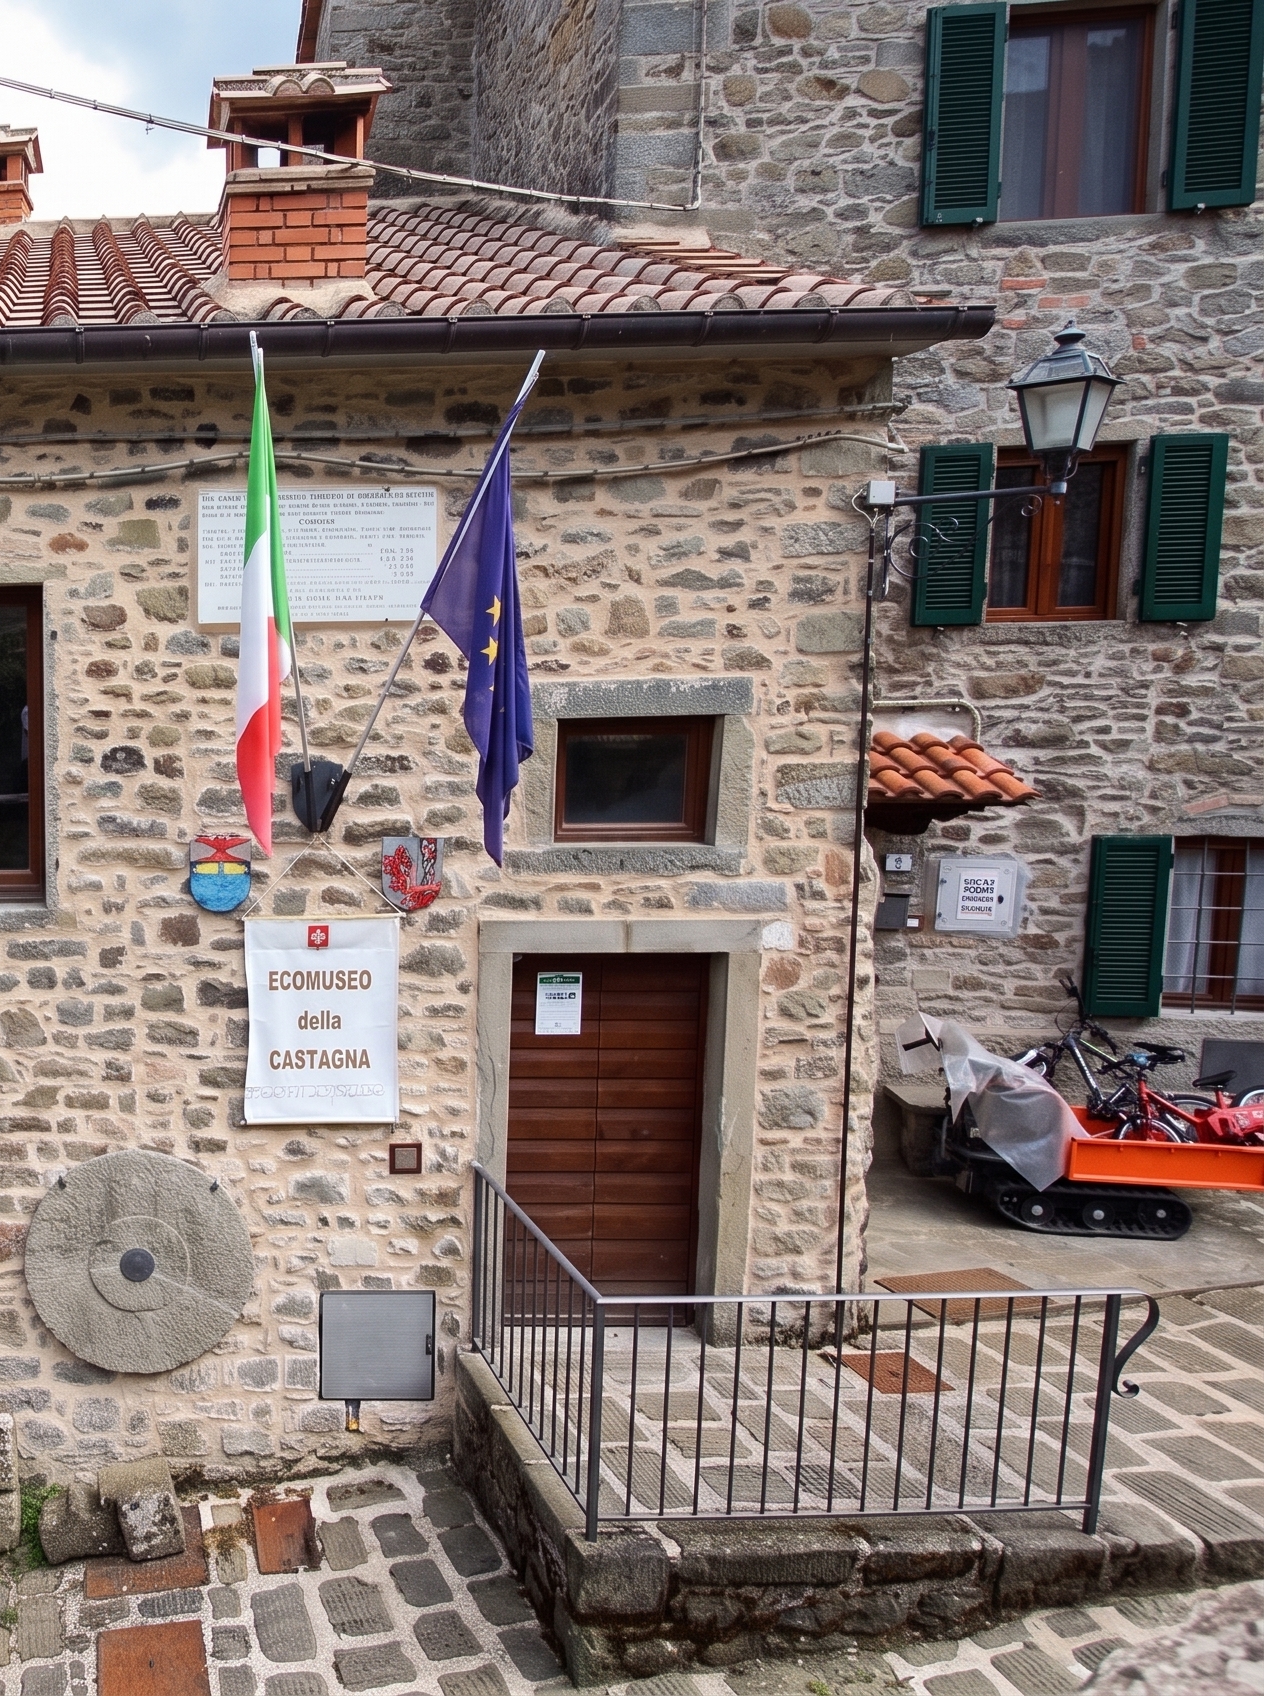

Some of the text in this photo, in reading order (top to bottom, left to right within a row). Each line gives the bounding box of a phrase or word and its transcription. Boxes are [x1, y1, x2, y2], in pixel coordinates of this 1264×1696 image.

[268, 969, 372, 991] ECOMUSEO
[297, 1010, 342, 1031] della
[269, 1048, 371, 1070] CASTAGNA
